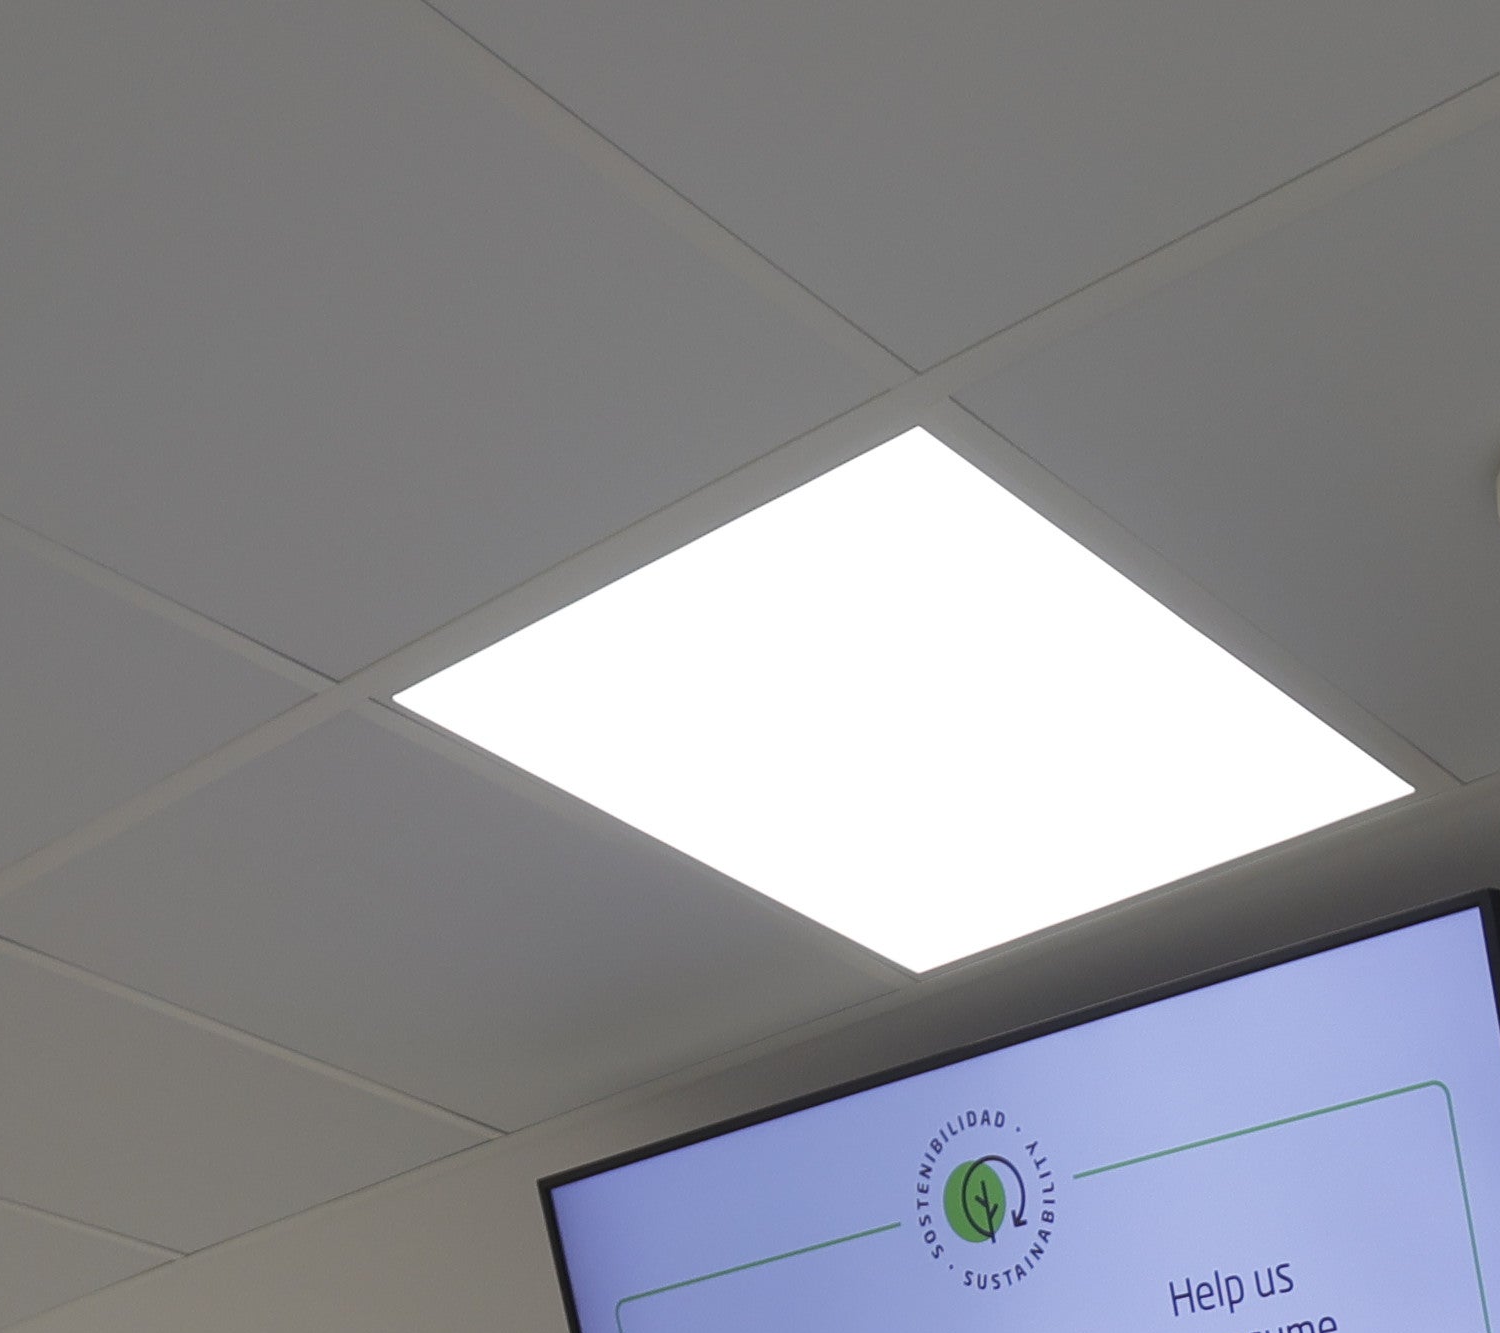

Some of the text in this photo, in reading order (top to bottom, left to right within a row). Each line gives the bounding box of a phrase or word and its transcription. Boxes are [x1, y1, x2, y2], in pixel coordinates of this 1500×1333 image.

[916, 1109, 1006, 1260] SOSTENIBILIDAD
[963, 1140, 1056, 1291] SUSTAINABILITY
[1168, 1262, 1294, 1317] Help us
